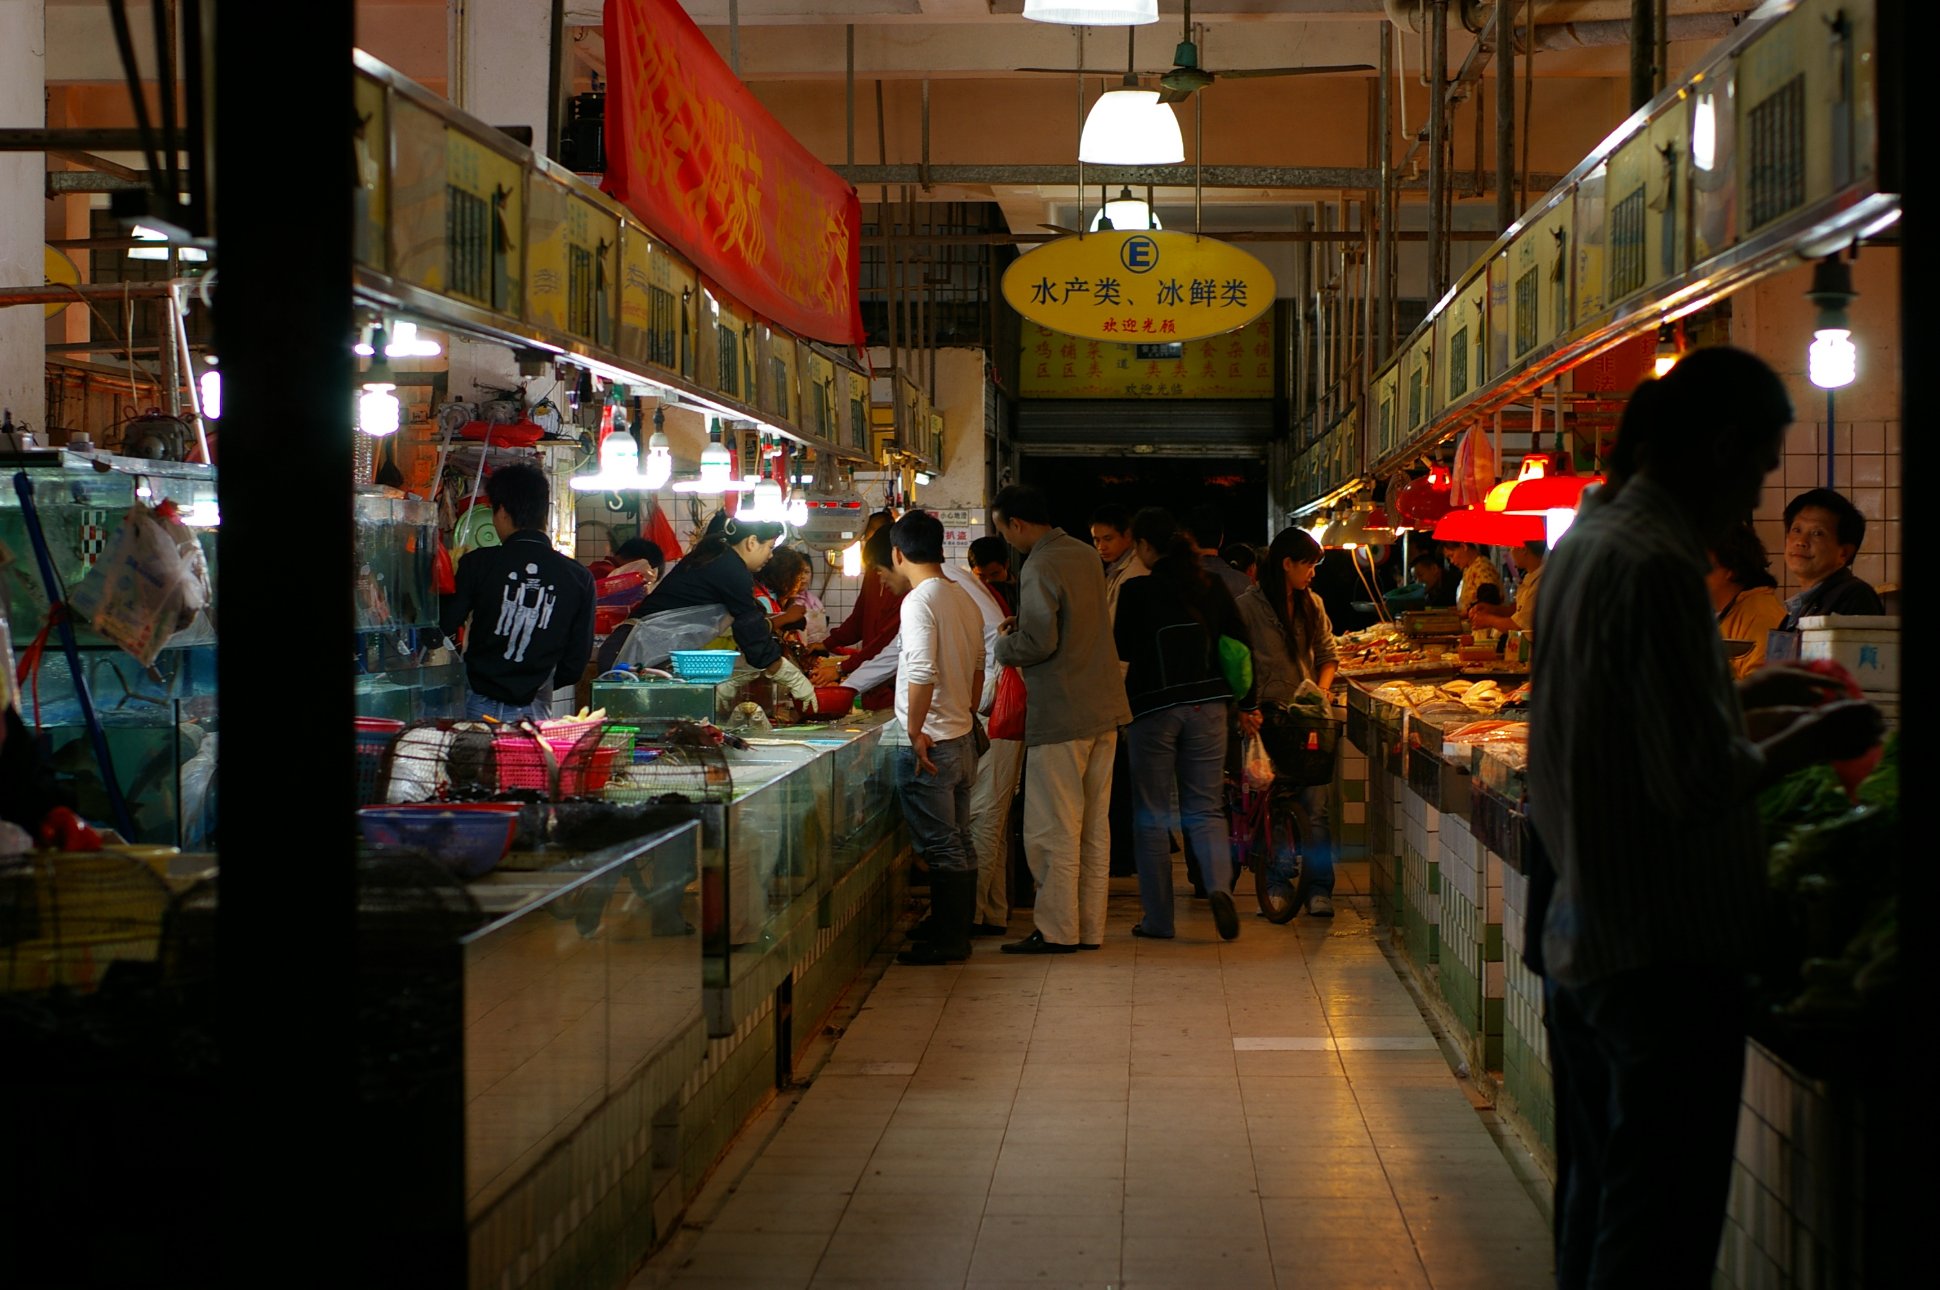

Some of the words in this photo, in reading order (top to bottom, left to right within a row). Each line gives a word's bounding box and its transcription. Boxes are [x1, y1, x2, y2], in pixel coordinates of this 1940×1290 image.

[1030, 276, 1249, 308] 水产类、冰鲜类
[1102, 317, 1176, 334] 欢迎光顾
